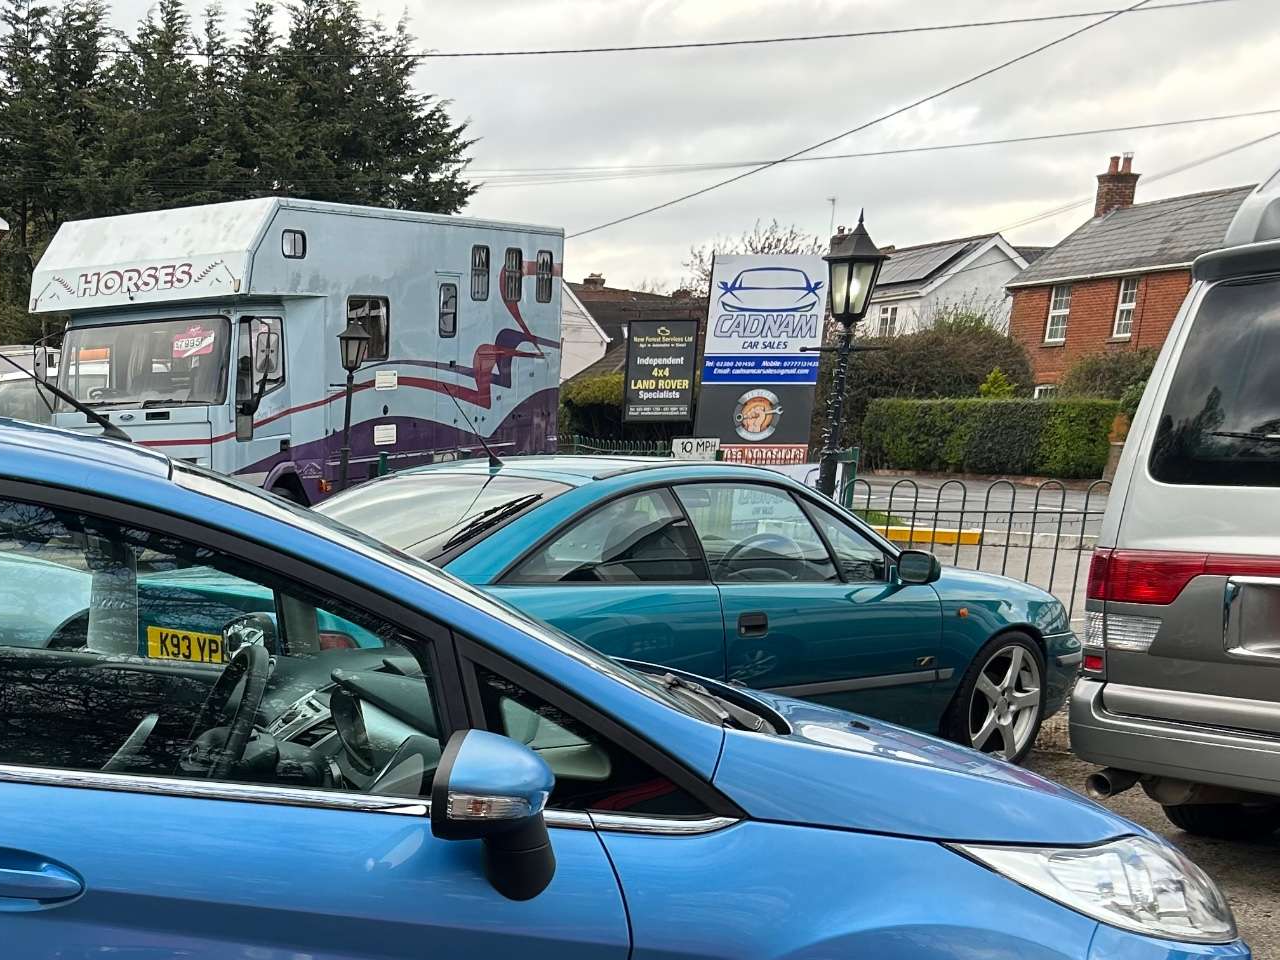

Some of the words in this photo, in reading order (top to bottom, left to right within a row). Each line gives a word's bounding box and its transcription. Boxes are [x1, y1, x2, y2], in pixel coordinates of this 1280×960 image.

[77, 263, 192, 297] HORSES
[714, 314, 819, 338] CADNAM
[742, 341, 759, 349] CAR
[761, 341, 788, 349] SALES
[637, 356, 684, 367] Independent
[652, 367, 670, 377] 4x4
[631, 380, 656, 389] LAND
[658, 380, 689, 389] ROVER
[638, 390, 680, 400] Specialists
[681, 441, 693, 453] 10
[696, 440, 716, 452] MPH
[160, 632, 192, 659] K93
